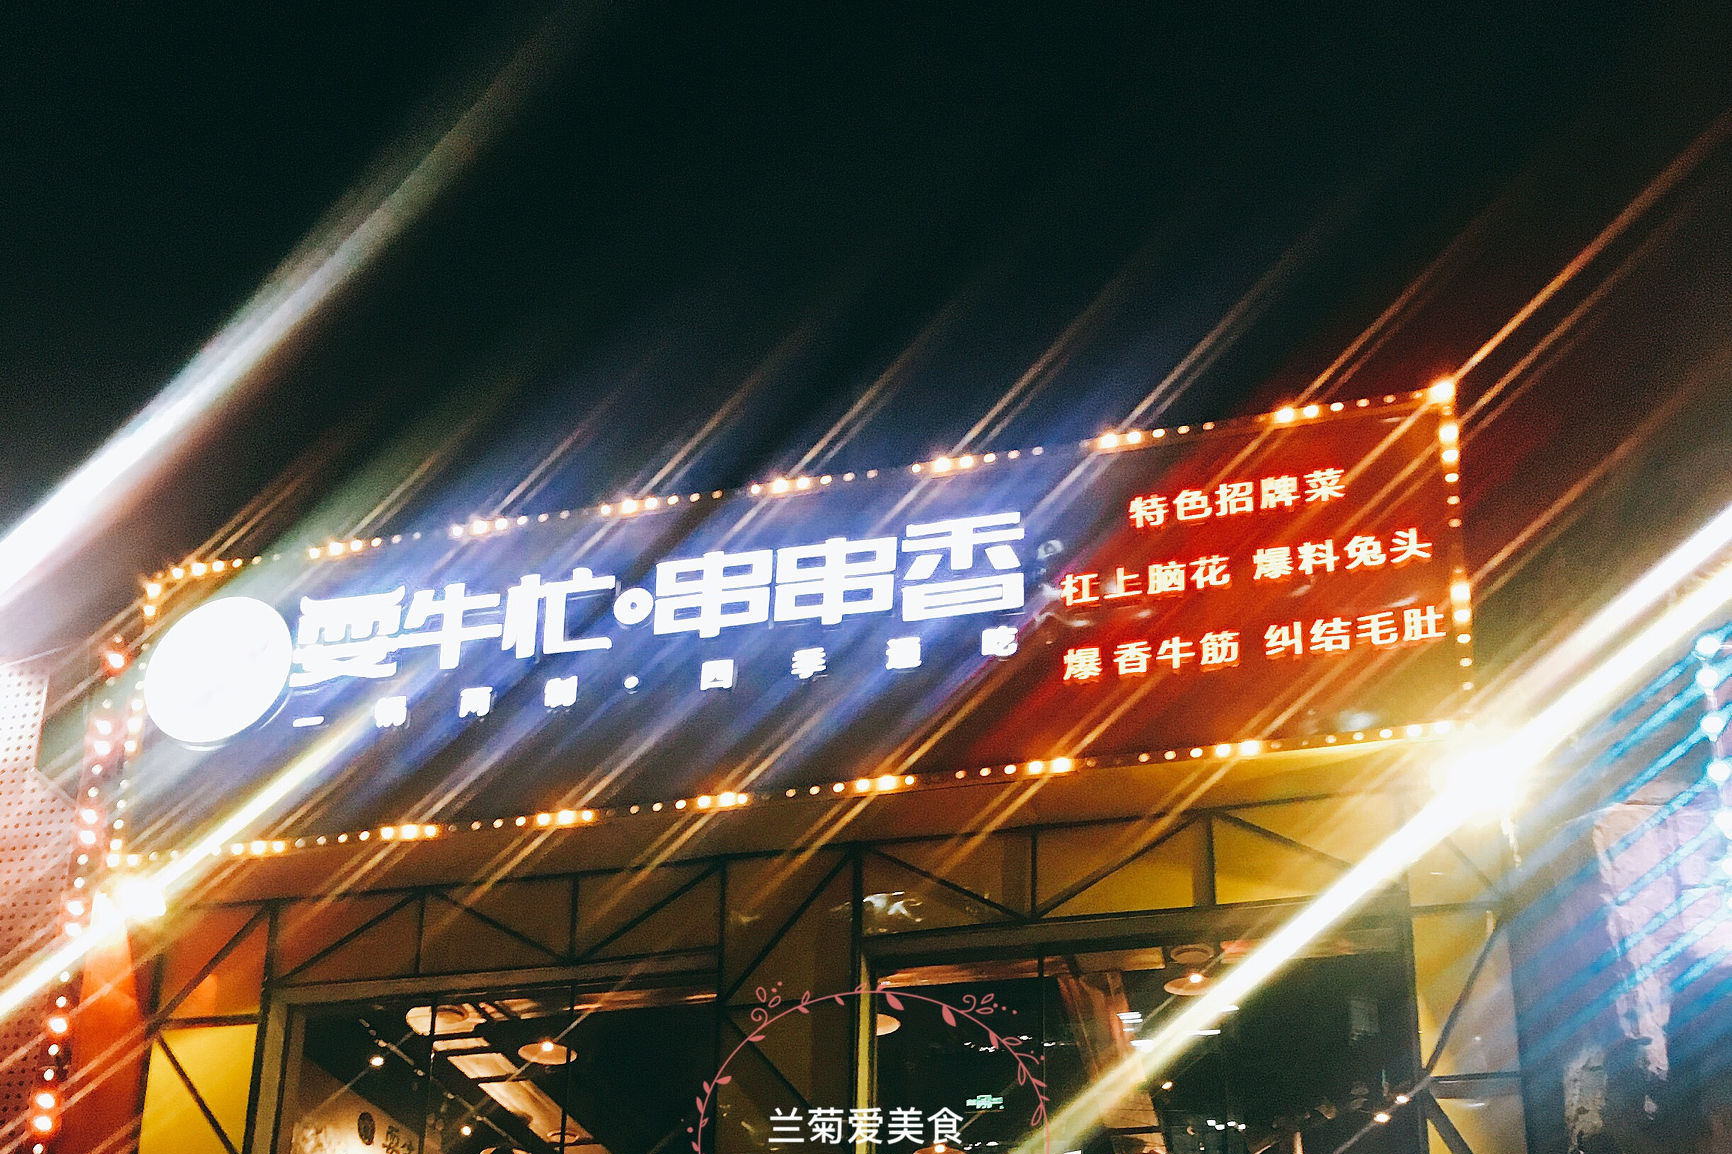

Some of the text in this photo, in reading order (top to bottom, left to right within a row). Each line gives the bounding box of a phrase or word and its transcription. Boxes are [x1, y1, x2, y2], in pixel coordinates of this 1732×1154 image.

[1129, 468, 1346, 528] 特色招牌菜
[1060, 529, 1432, 606] 杠上脑花 爆料兔头
[1063, 606, 1446, 681] 爆香牛筋 纠结毛肚
